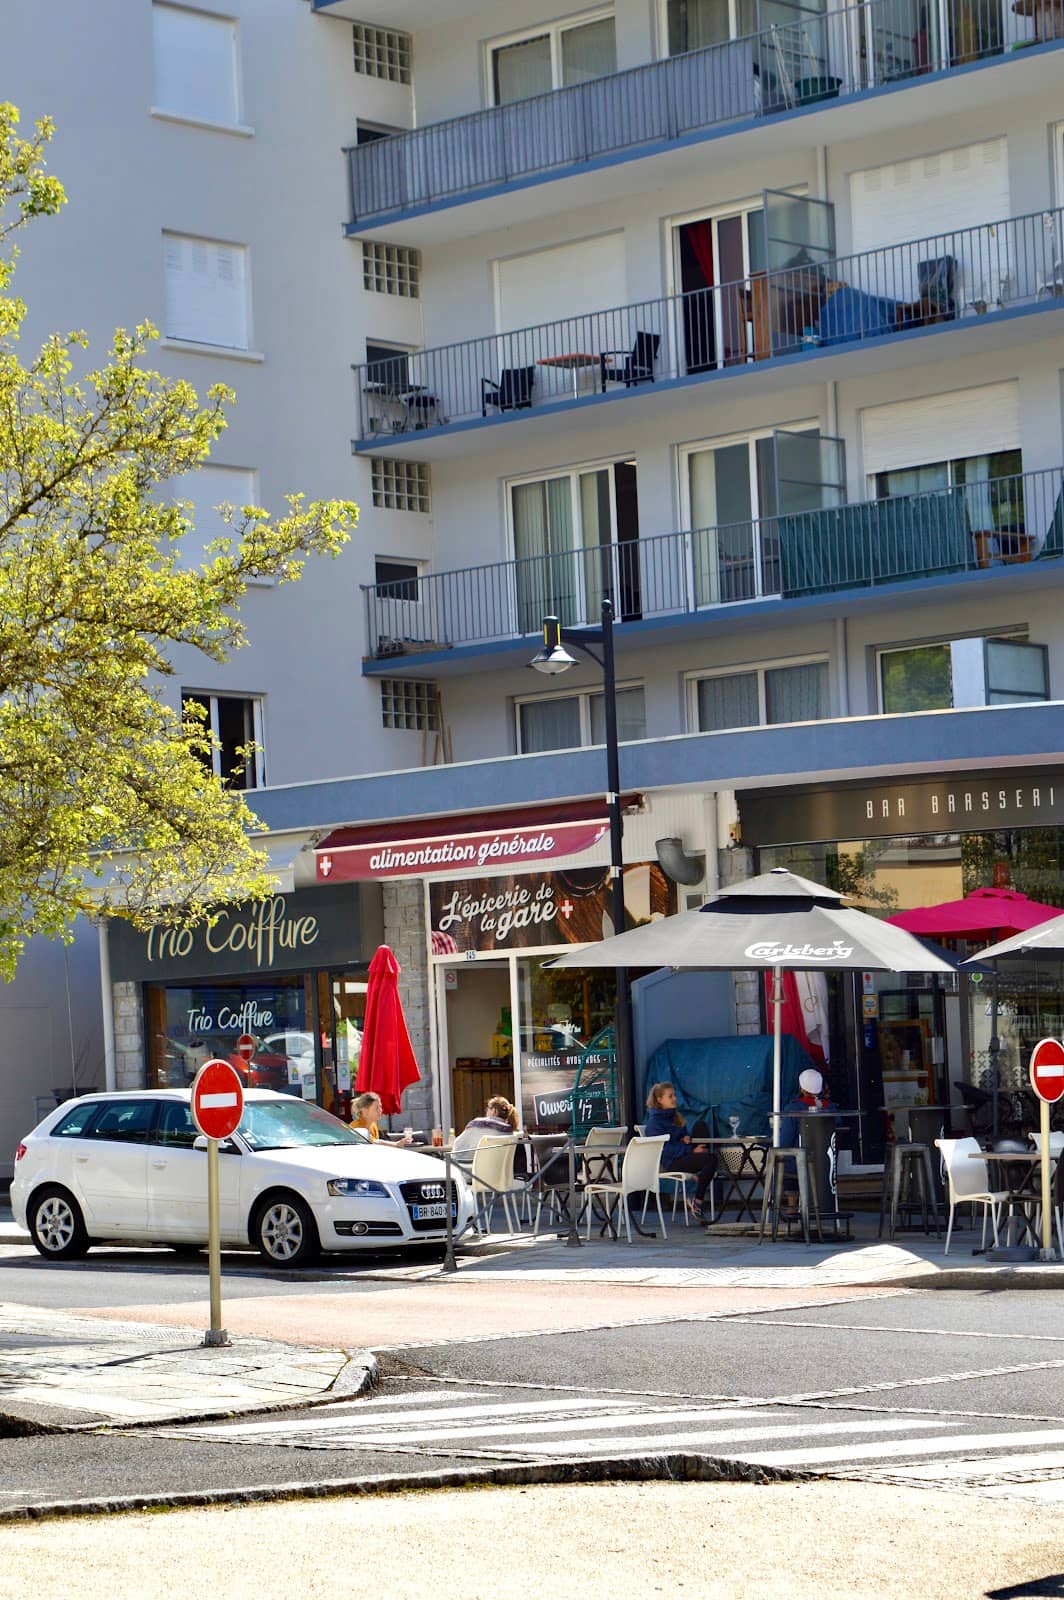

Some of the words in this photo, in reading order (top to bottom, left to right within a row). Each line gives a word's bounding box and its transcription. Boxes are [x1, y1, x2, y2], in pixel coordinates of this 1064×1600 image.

[866, 798, 905, 819] BAR
[931, 787, 1054, 814] BRASSERI
[369, 841, 477, 870] alimentation
[478, 833, 555, 866] générale
[439, 884, 531, 931] L'épicerie
[535, 882, 554, 899] de
[480, 916, 497, 932] la
[495, 900, 559, 941] gare
[205, 896, 320, 967] Coiffure
[744, 940, 854, 963] Carlsberg
[187, 1006, 213, 1033] Trio
[217, 1001, 274, 1035] Coiffure
